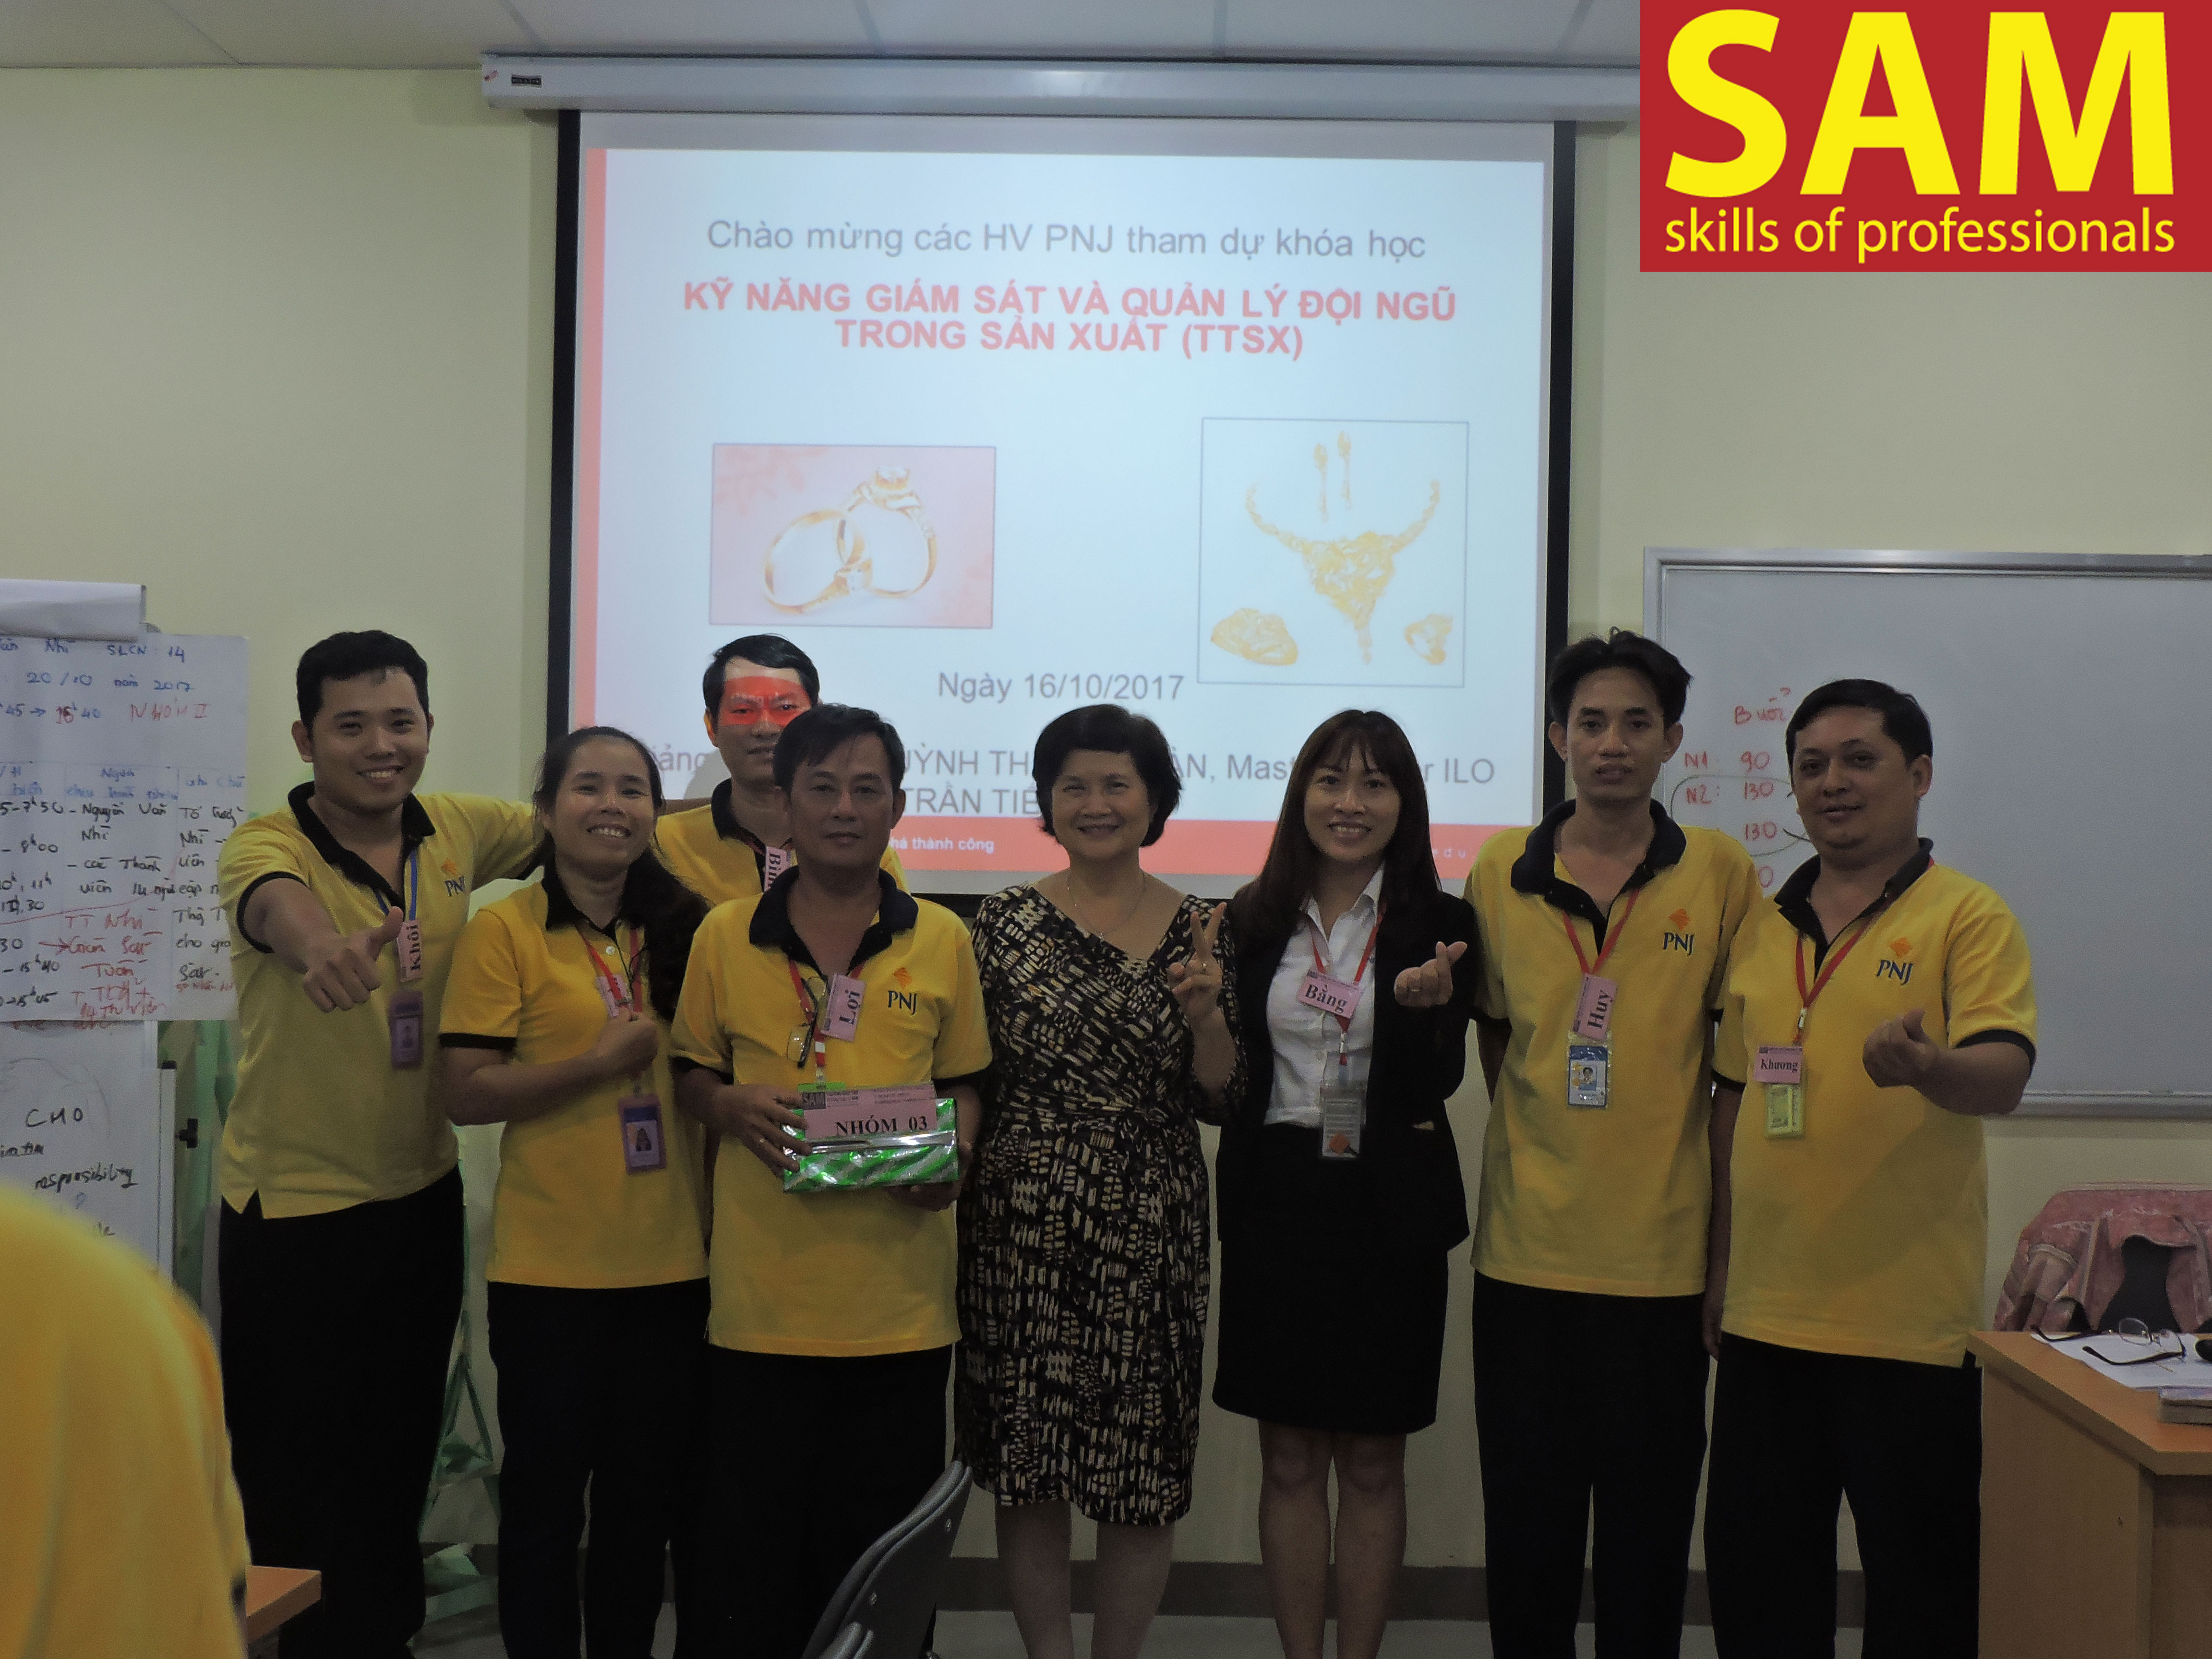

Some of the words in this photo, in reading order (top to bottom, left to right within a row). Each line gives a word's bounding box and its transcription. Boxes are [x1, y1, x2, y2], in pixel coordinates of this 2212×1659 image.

[708, 220, 793, 249] Chào
[807, 222, 903, 257] mừng
[914, 224, 972, 251] các
[984, 224, 1033, 251] HV
[1046, 224, 1113, 253] PNJ
[1127, 227, 1206, 254] tham
[1221, 227, 1264, 260] dự
[1276, 228, 1353, 257] khóa
[1369, 230, 1426, 263] học
[684, 277, 734, 311] KỸ
[747, 277, 851, 312] NĂNG
[866, 278, 959, 313] GIÁM
[974, 279, 1047, 314] SÁT
[1059, 281, 1109, 315] VÀ
[1121, 282, 1225, 318] QUẢN
[1242, 283, 1288, 318] LÝ
[1376, 286, 1456, 322] NGŨ
[835, 319, 967, 349] TRONG
[980, 313, 1055, 350] SẢN
[1182, 324, 1303, 361] (TTSX)
[938, 672, 1013, 704] Ngày
[1028, 673, 1184, 701] 16/10/2017
[1445, 758, 1495, 784] ILO
[1663, 932, 1694, 956] PNJ
[1876, 960, 1914, 986] PNJ
[888, 990, 917, 1015] PNJ
[1587, 990, 1613, 1029] Huy
[835, 1115, 897, 1136] NHÓM
[908, 1116, 928, 1130] 03
